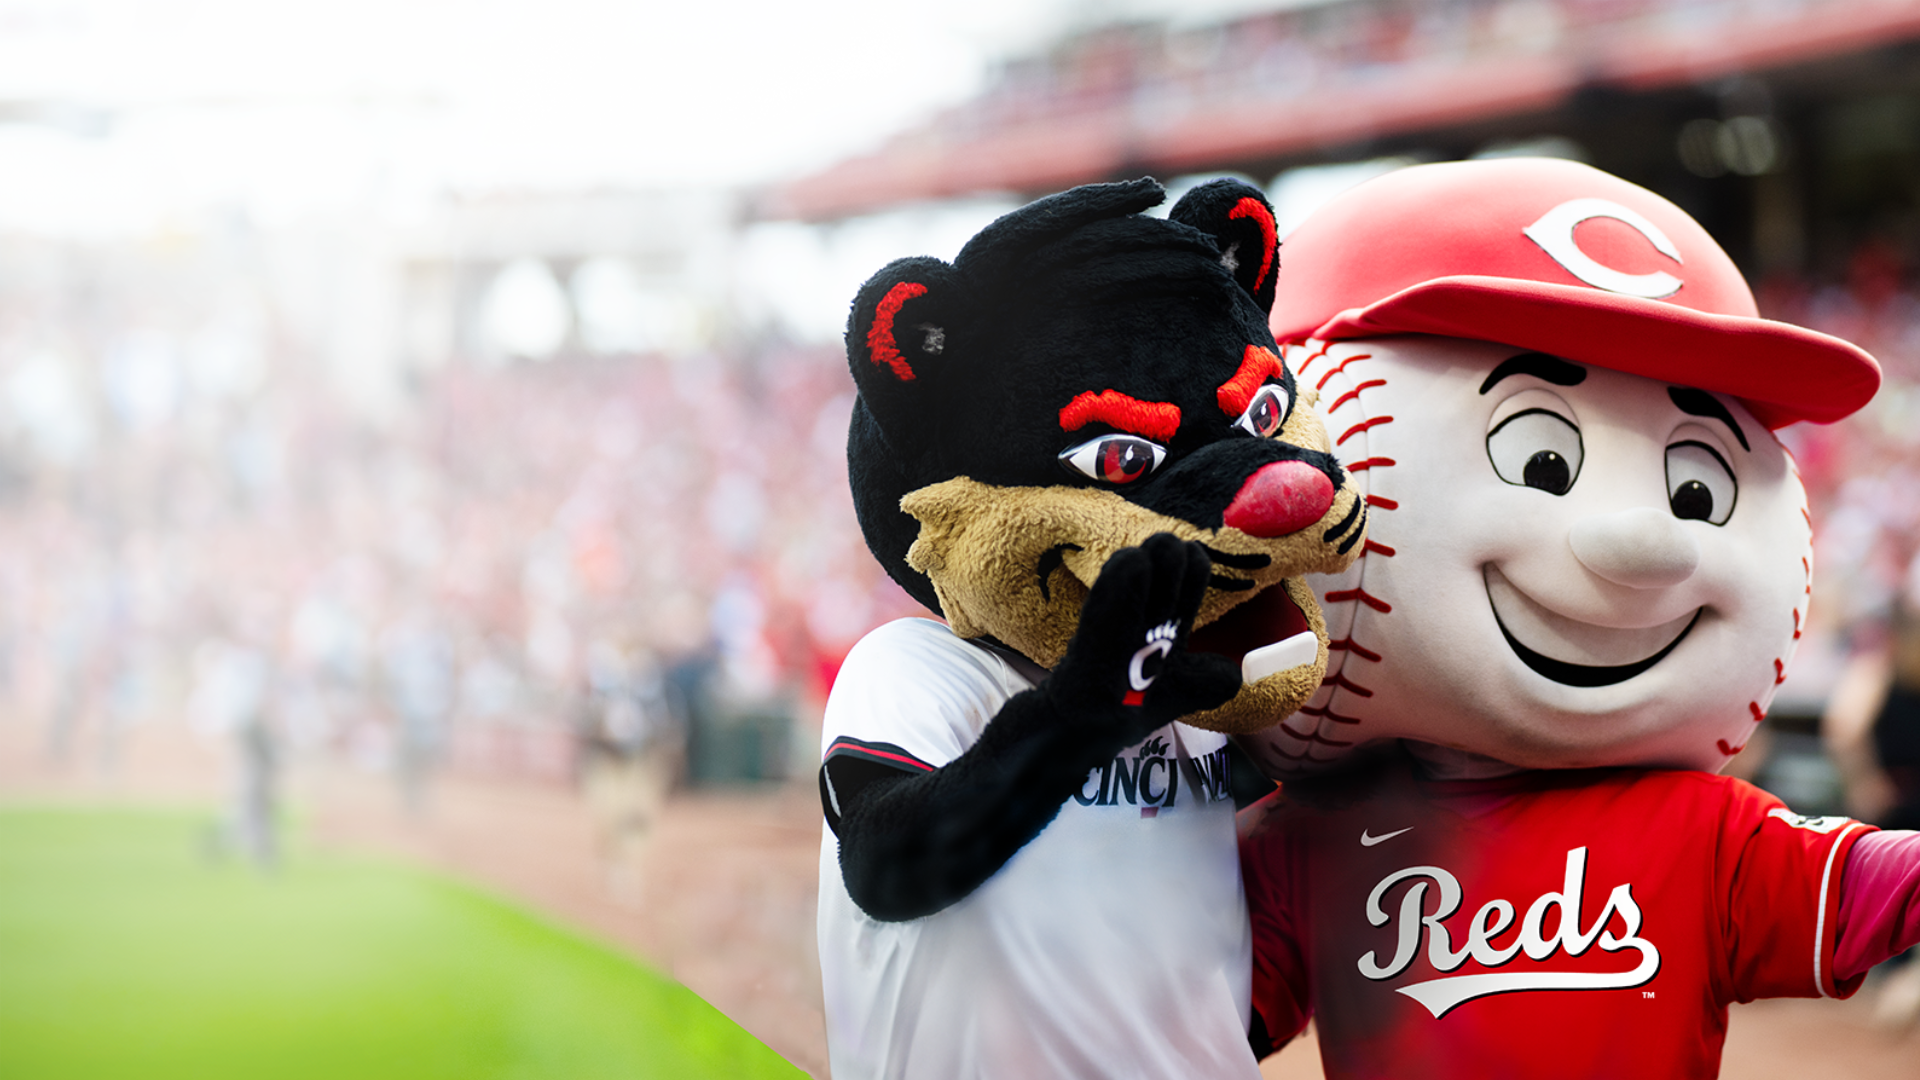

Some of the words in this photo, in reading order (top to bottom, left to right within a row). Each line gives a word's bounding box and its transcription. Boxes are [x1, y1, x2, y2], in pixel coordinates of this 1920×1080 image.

[1522, 198, 1684, 300] C
[1357, 846, 1661, 1019] Reds
[1641, 991, 1655, 999] TM
